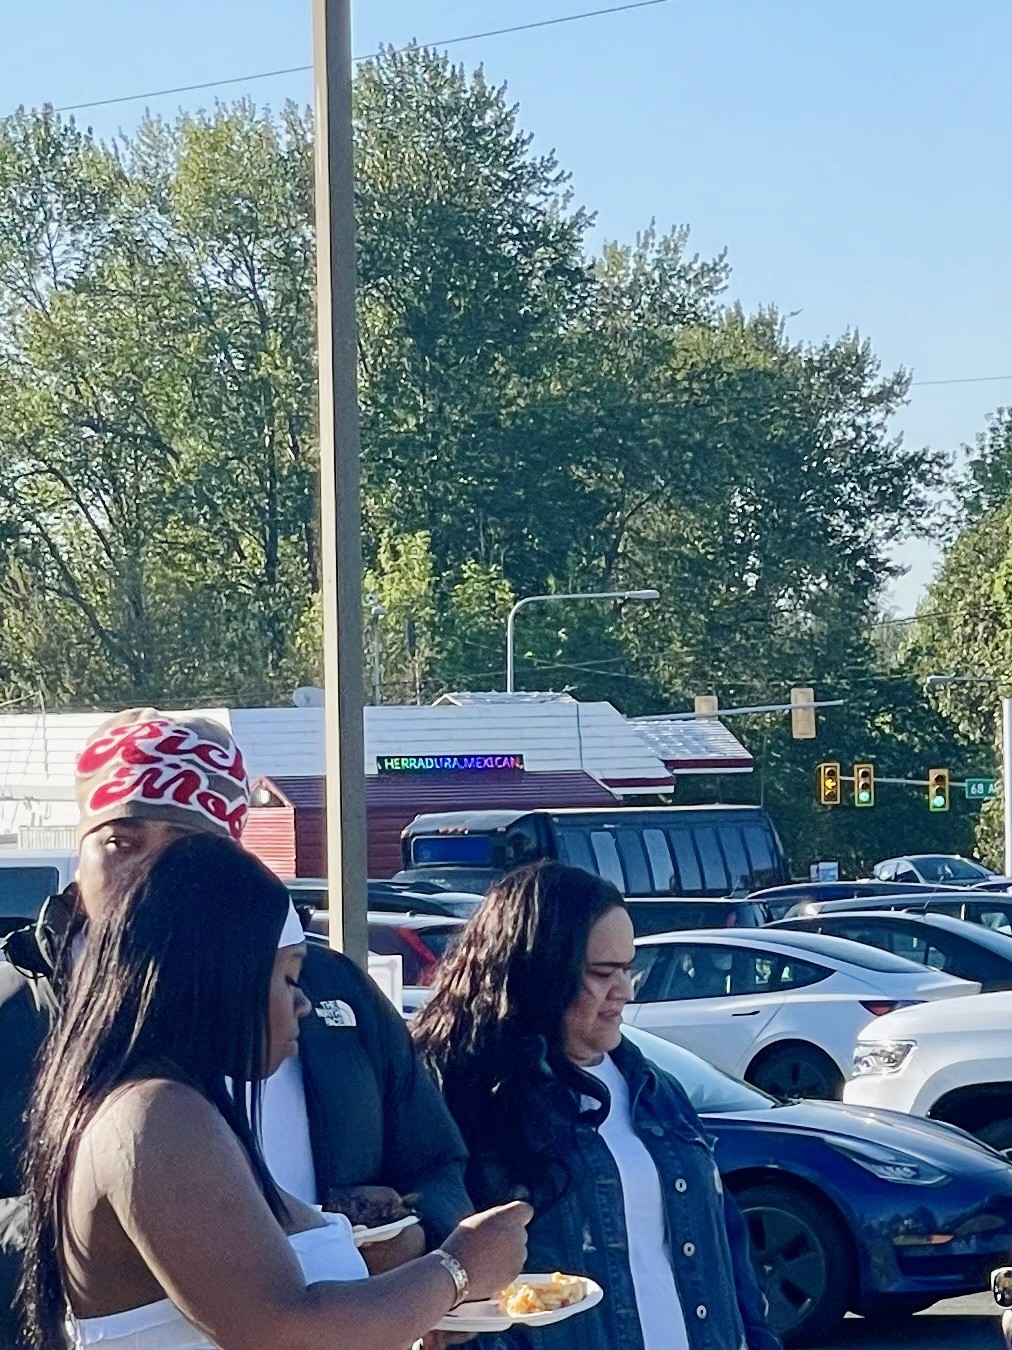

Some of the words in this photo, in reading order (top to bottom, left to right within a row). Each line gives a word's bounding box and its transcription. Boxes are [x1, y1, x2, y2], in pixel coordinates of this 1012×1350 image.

[384, 757, 462, 770] HERRADURA
[463, 756, 521, 769] MEXICAN
[970, 783, 984, 795] 68
